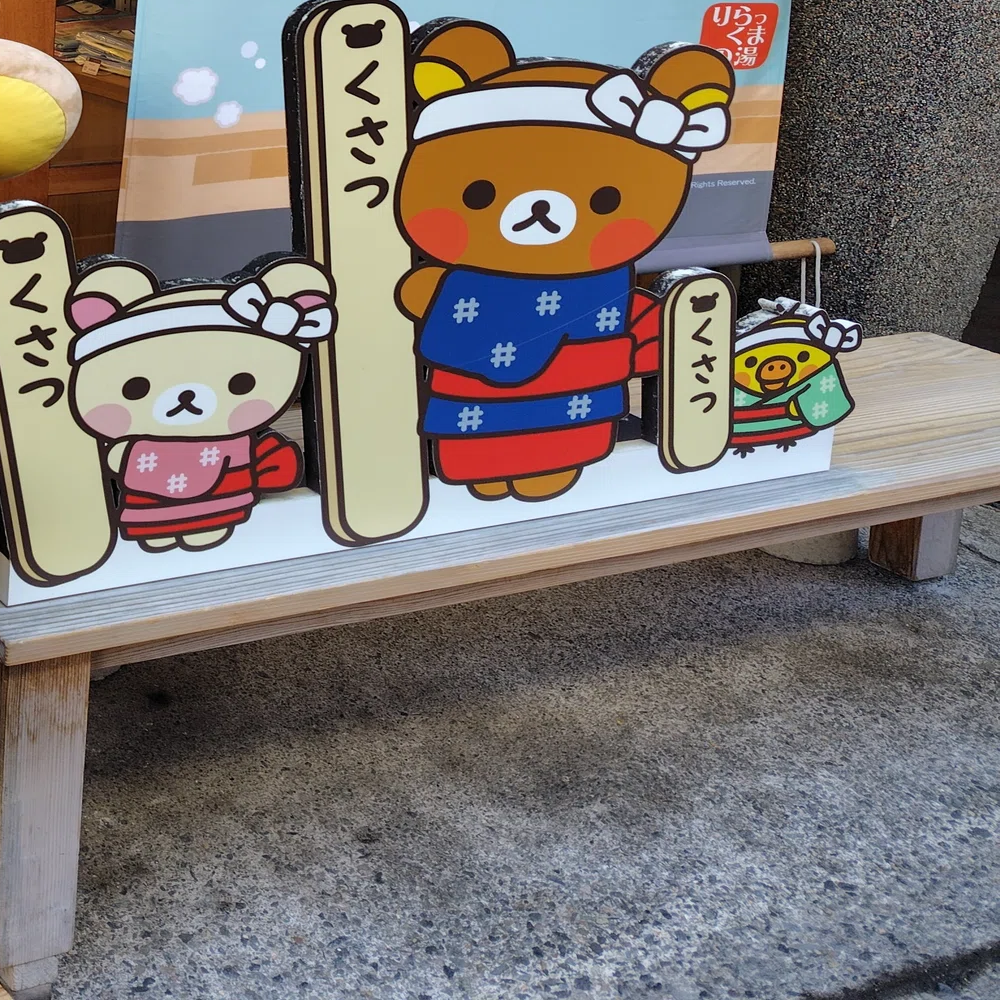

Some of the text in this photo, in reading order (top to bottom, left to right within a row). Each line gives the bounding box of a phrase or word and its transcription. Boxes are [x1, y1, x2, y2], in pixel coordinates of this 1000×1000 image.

[712, 5, 768, 27] りらっ
[726, 25, 767, 46] くま
[344, 60, 390, 209] くさつ
[691, 178, 757, 189] Rights Reserved.
[10, 273, 65, 408] くさつ
[689, 317, 718, 413] くさつ
